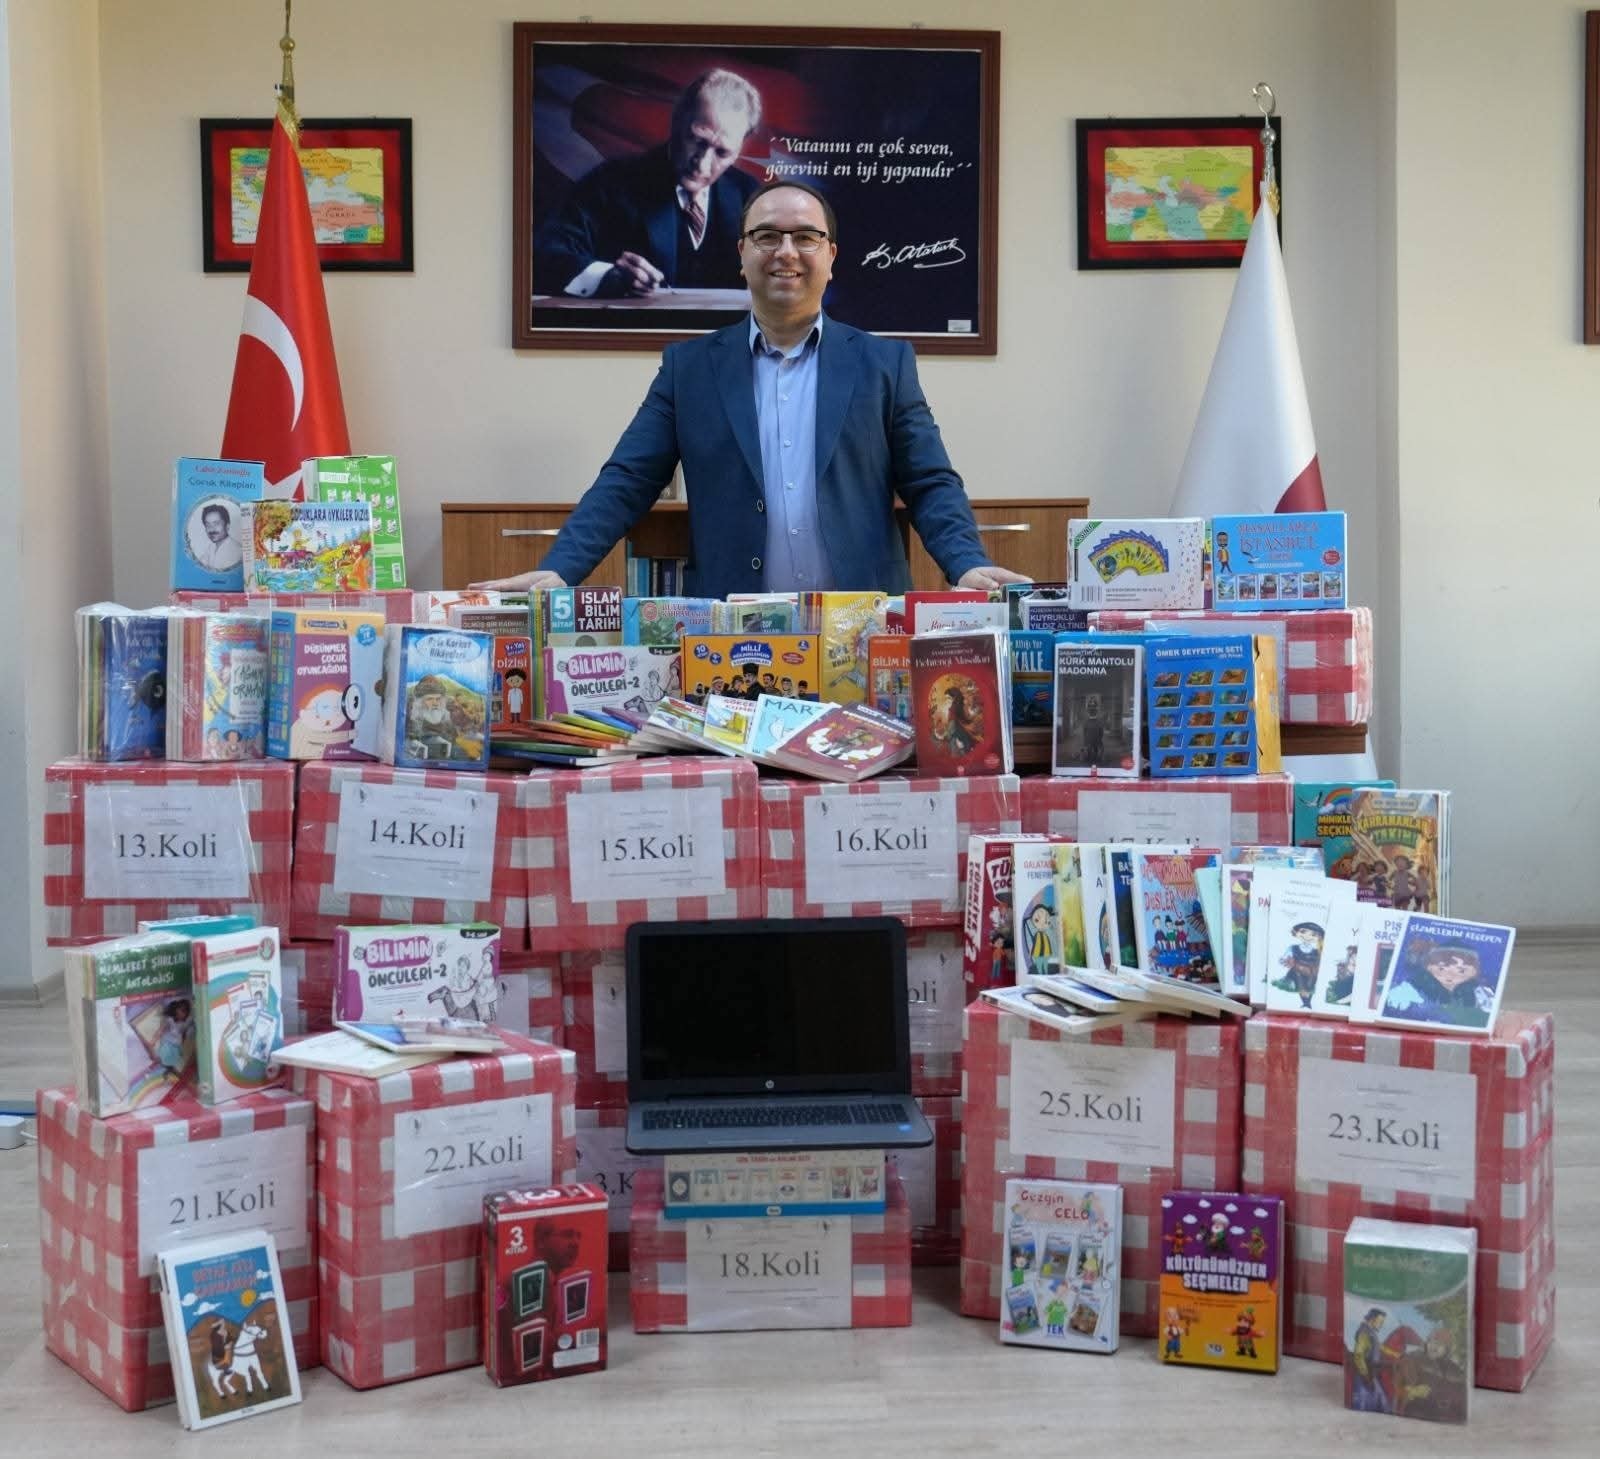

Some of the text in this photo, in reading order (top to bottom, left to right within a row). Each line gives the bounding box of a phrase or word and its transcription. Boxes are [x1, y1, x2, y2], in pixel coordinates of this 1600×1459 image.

[856, 141, 873, 154] en
[878, 137, 905, 158] çok
[908, 142, 954, 157] seven,
[764, 160, 828, 182] görevini
[833, 164, 851, 177] en
[856, 161, 878, 183] iyi
[553, 594, 572, 620] 5
[1030, 613, 1075, 621] KUYRUKLU
[1030, 621, 1055, 630] YILDIZ
[568, 651, 626, 676] BİLİMİN
[1059, 655, 1135, 666] KÜRK MANTOLU
[1059, 666, 1107, 676] MADONNA
[117, 832, 218, 860] 13.Koli
[369, 816, 466, 850] 14.Koli
[835, 826, 928, 852] 16.Koli
[600, 833, 695, 862] 15.Koli
[365, 938, 434, 964] BİLİMİN
[1038, 1090, 1143, 1123] 25.Koli
[1327, 1112, 1441, 1151] 23.Koli
[423, 1135, 524, 1175] 22.Koli
[169, 1181, 276, 1226] 21.Koli
[510, 1225, 524, 1247] 3
[719, 1250, 821, 1279] 18.Koli
[1165, 1254, 1268, 1279] KÜLTÜRÜMÜZDEN
[1182, 1273, 1249, 1293] SEÇMELER
